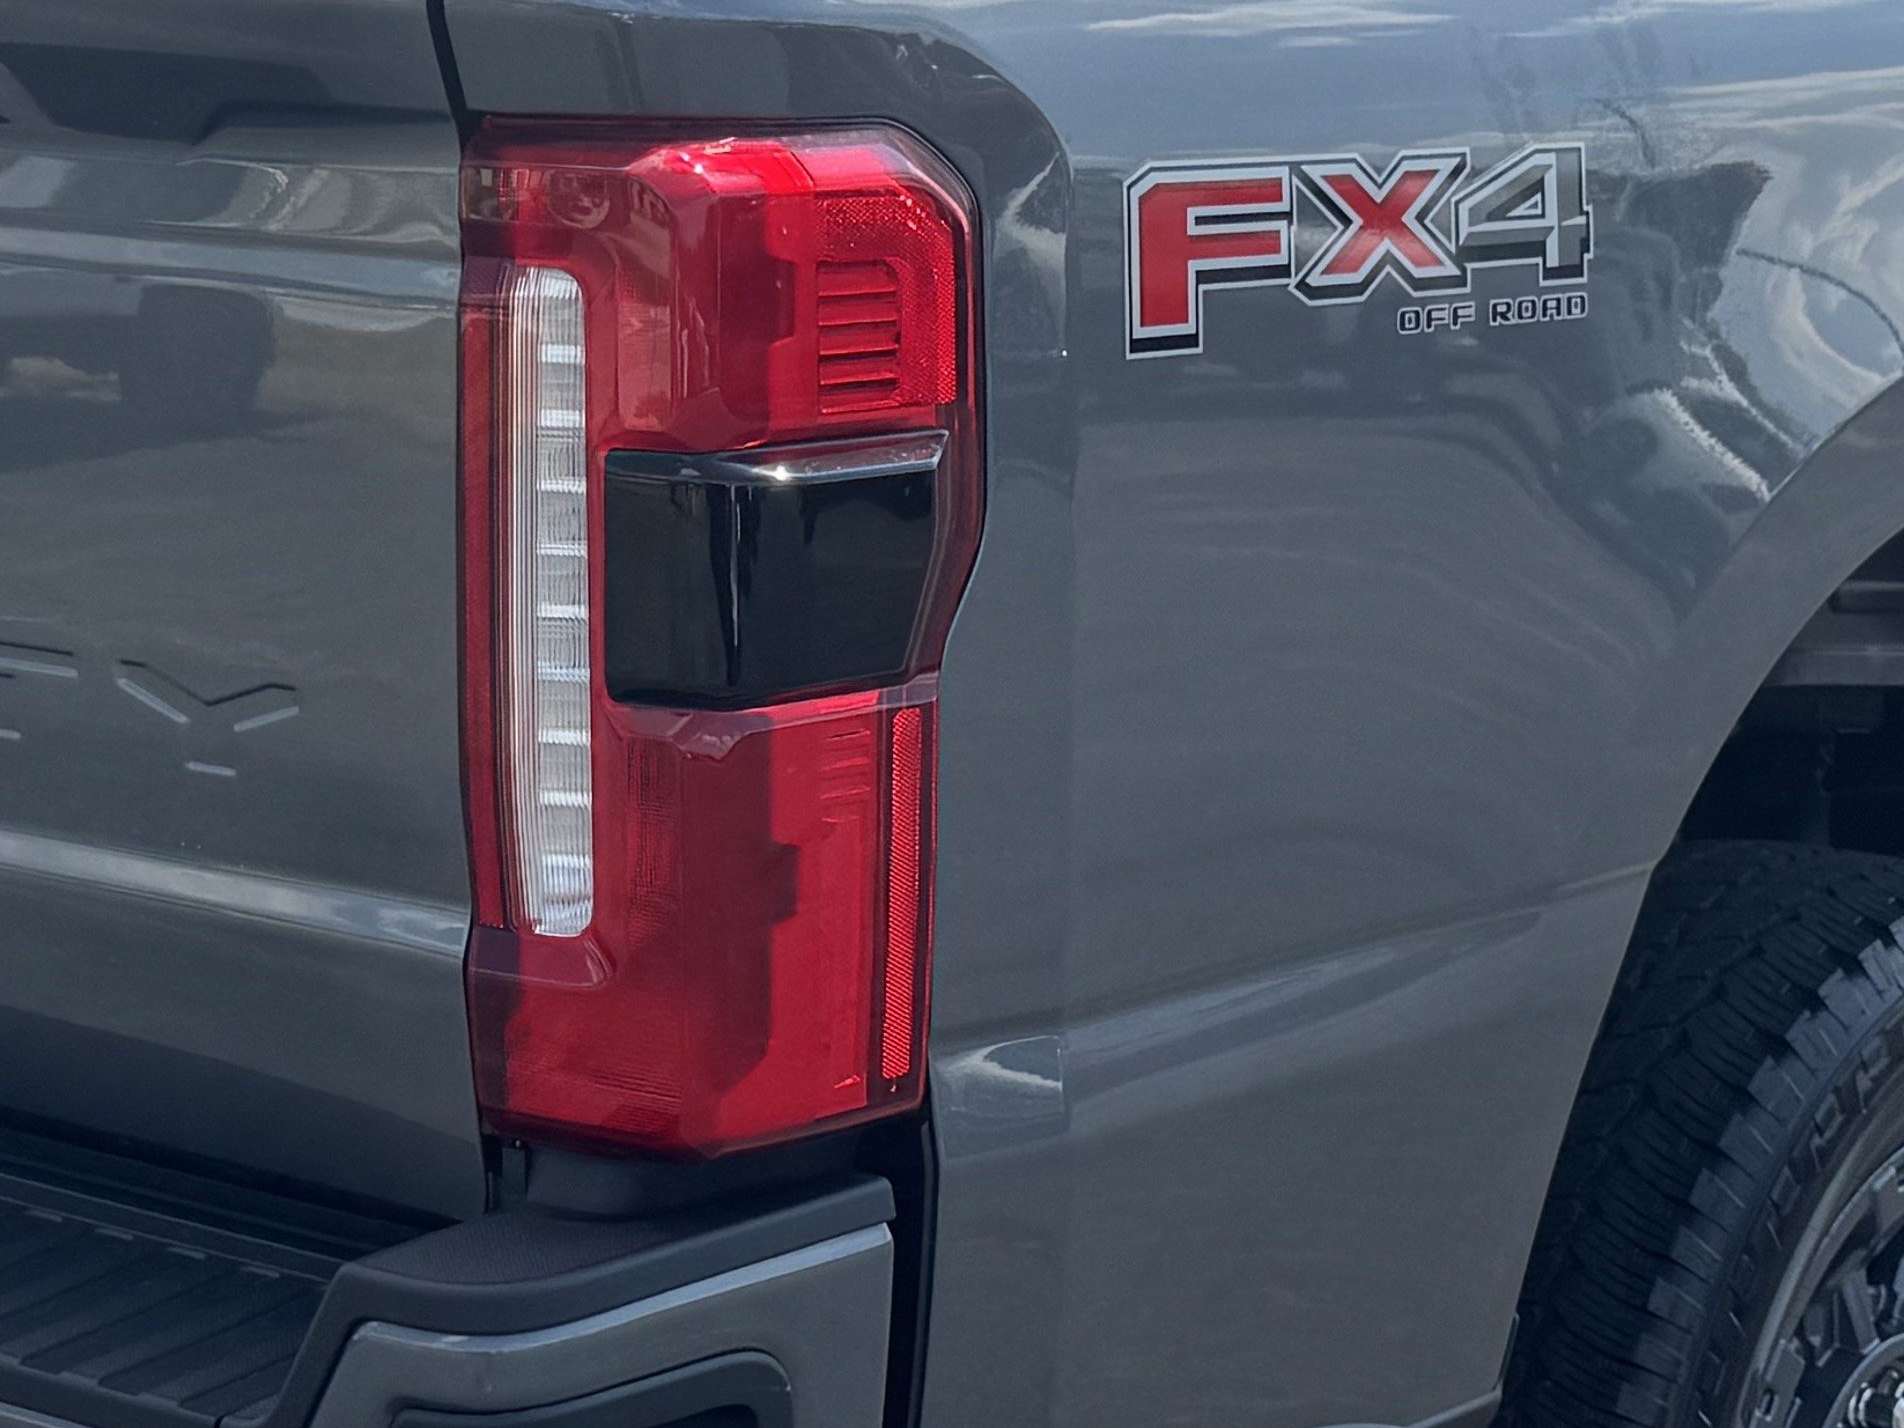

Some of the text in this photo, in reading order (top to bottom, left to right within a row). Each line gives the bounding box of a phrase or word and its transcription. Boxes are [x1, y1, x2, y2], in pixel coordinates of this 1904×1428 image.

[1123, 141, 1593, 359] FX4
[1397, 292, 1588, 335] OFF ROAD
